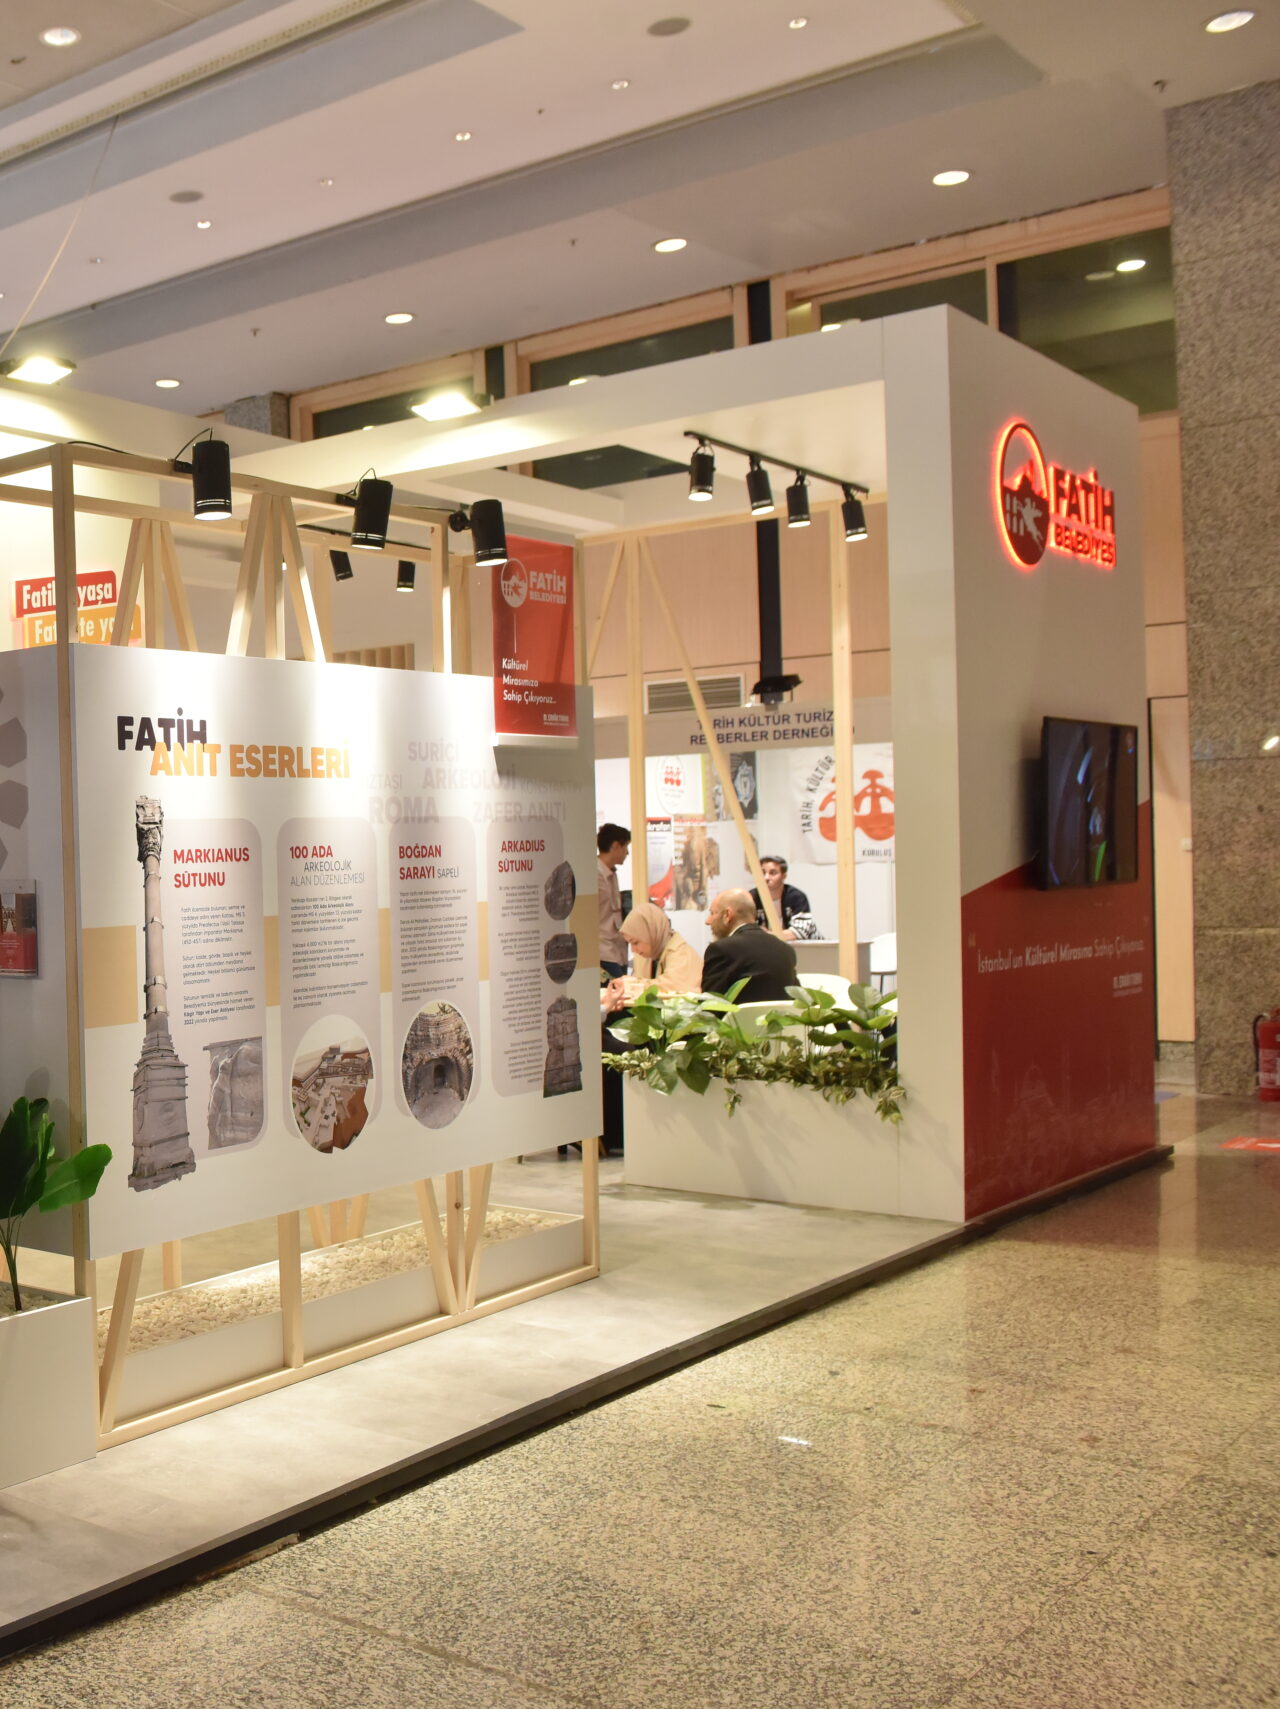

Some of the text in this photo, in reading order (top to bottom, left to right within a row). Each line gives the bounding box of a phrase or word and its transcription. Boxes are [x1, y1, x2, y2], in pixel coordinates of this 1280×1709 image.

[1051, 466, 1116, 535] FATİH
[529, 569, 567, 594] FATİH
[502, 658, 528, 671] Kültürel
[503, 689, 522, 704] Sahip
[697, 708, 834, 731] TRİH KÜLTÜR TURİZ
[117, 707, 207, 752] FATİH
[690, 730, 768, 746] REBERLER
[150, 739, 350, 778] ANIT ESERLERİ
[289, 845, 334, 859] 100 ADA
[399, 843, 442, 859] BOĞDAN
[500, 839, 546, 854] ARKADIUS
[173, 847, 250, 865] MARKIANUS
[399, 865, 435, 880] SARAYI
[290, 875, 312, 887] ALAN
